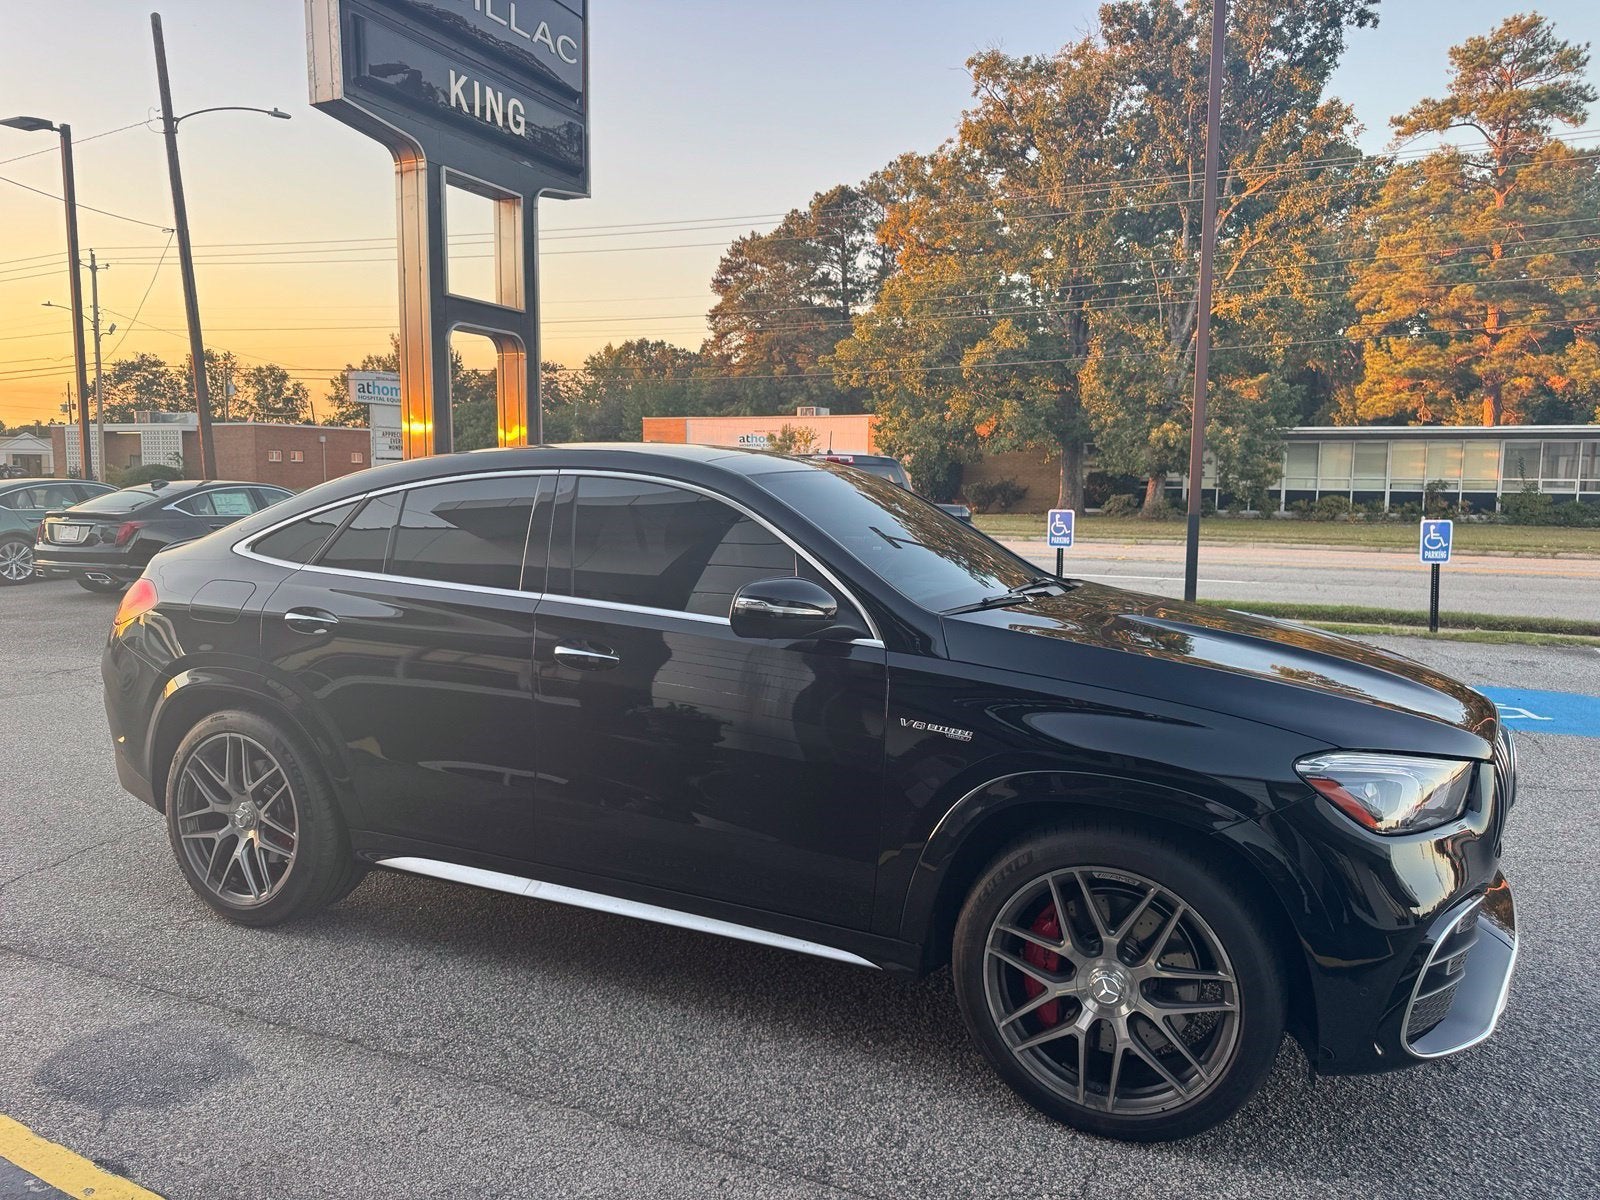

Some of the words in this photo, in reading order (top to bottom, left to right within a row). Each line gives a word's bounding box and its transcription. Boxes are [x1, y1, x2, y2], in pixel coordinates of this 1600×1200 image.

[449, 69, 526, 137] KING
[357, 381, 400, 396] athom
[1424, 551, 1447, 559] PARKING
[900, 717, 926, 730] V8
